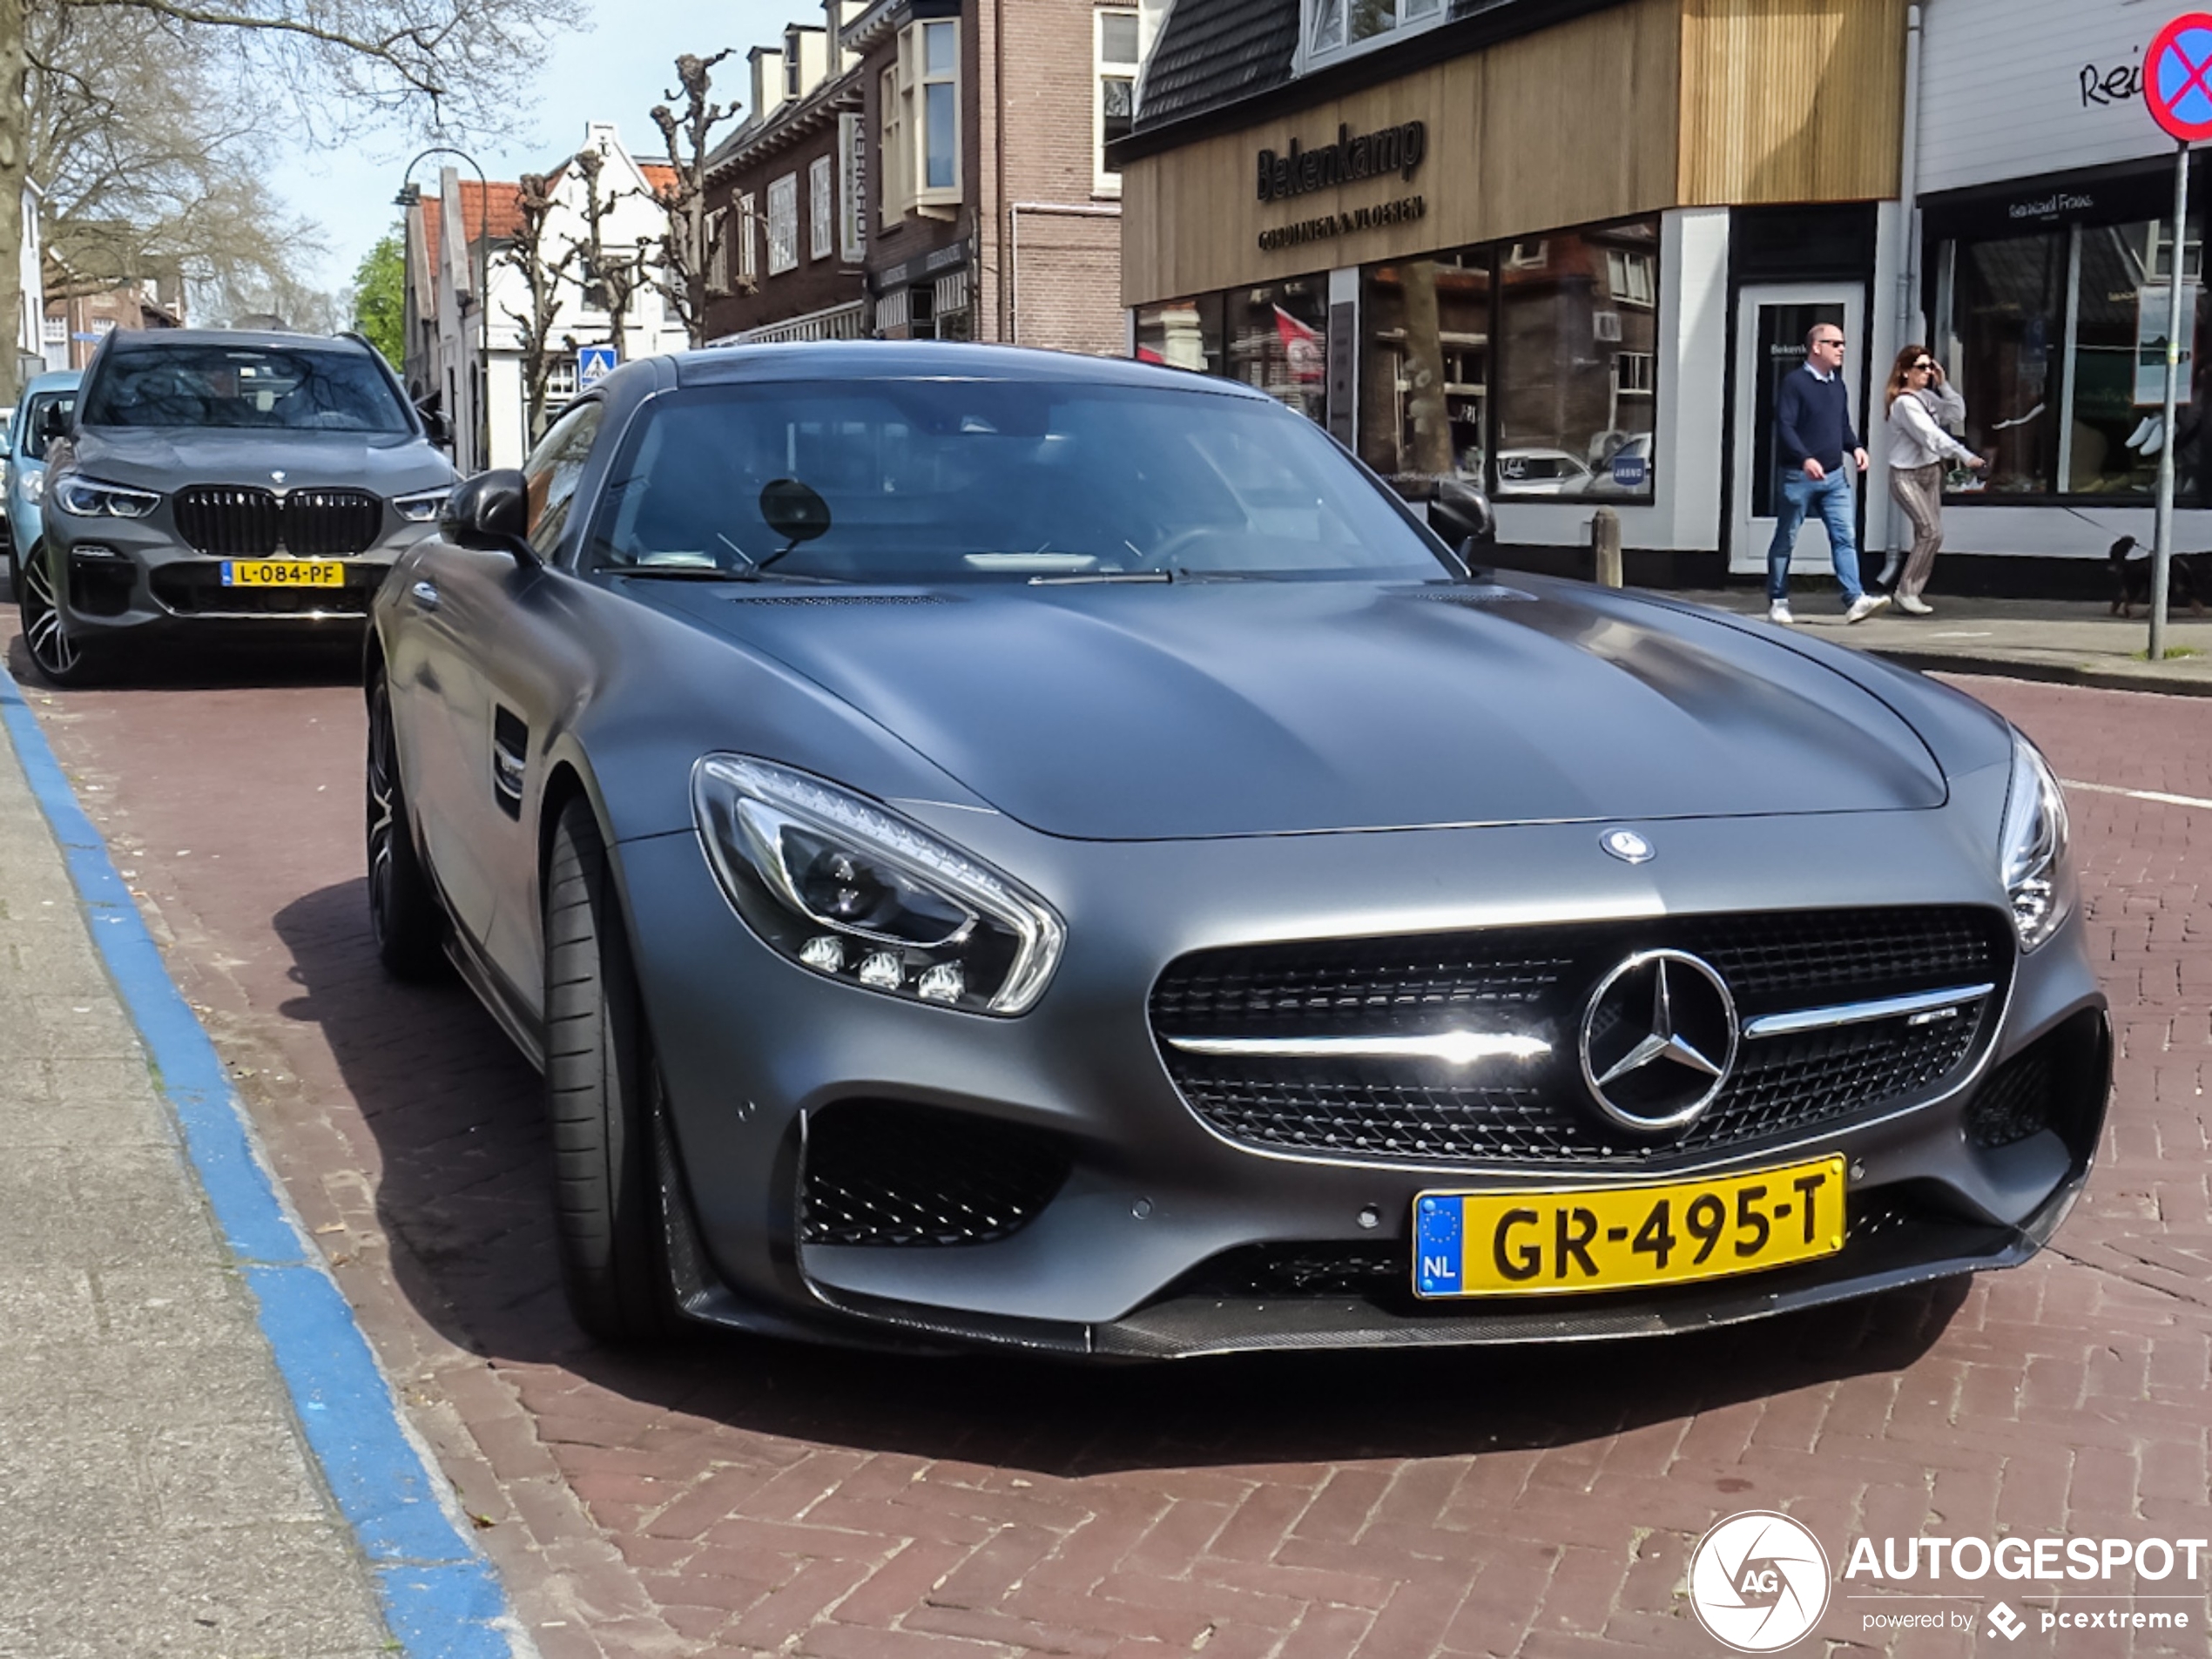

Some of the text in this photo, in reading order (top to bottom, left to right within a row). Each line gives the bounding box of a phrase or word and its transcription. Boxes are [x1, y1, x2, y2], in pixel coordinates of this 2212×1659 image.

[2080, 45, 2143, 107] Rei
[1258, 121, 1425, 200] Bekenkamp
[1258, 215, 1335, 250] GORDIJNEN
[1354, 195, 1425, 229] VLOEREN
[1770, 344, 1806, 354] Bekenk
[240, 564, 334, 583] L-084-PF
[1493, 1173, 1826, 1282] GR-495-T
[1424, 1256, 1455, 1278] NL
